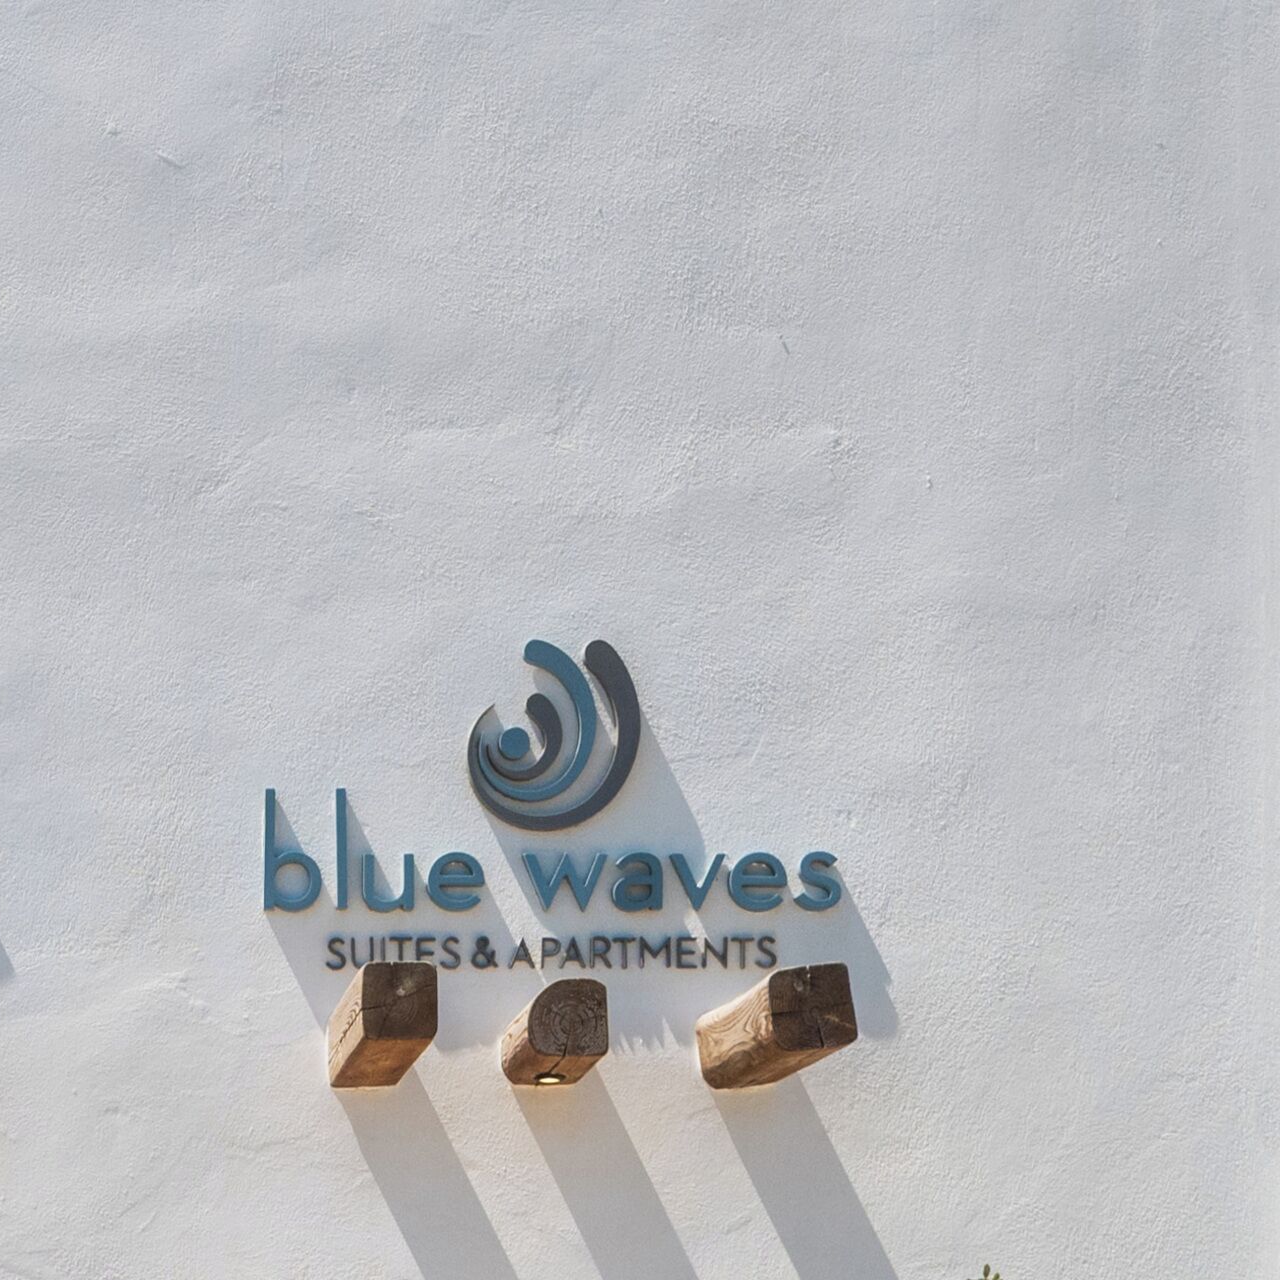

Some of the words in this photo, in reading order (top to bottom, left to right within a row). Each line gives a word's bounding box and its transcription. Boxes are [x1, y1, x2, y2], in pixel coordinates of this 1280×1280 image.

[263, 788, 485, 912] blue
[522, 851, 842, 912] waves
[326, 936, 461, 970] SUITES
[470, 936, 497, 969] &
[507, 936, 778, 970] APARTMENTS
